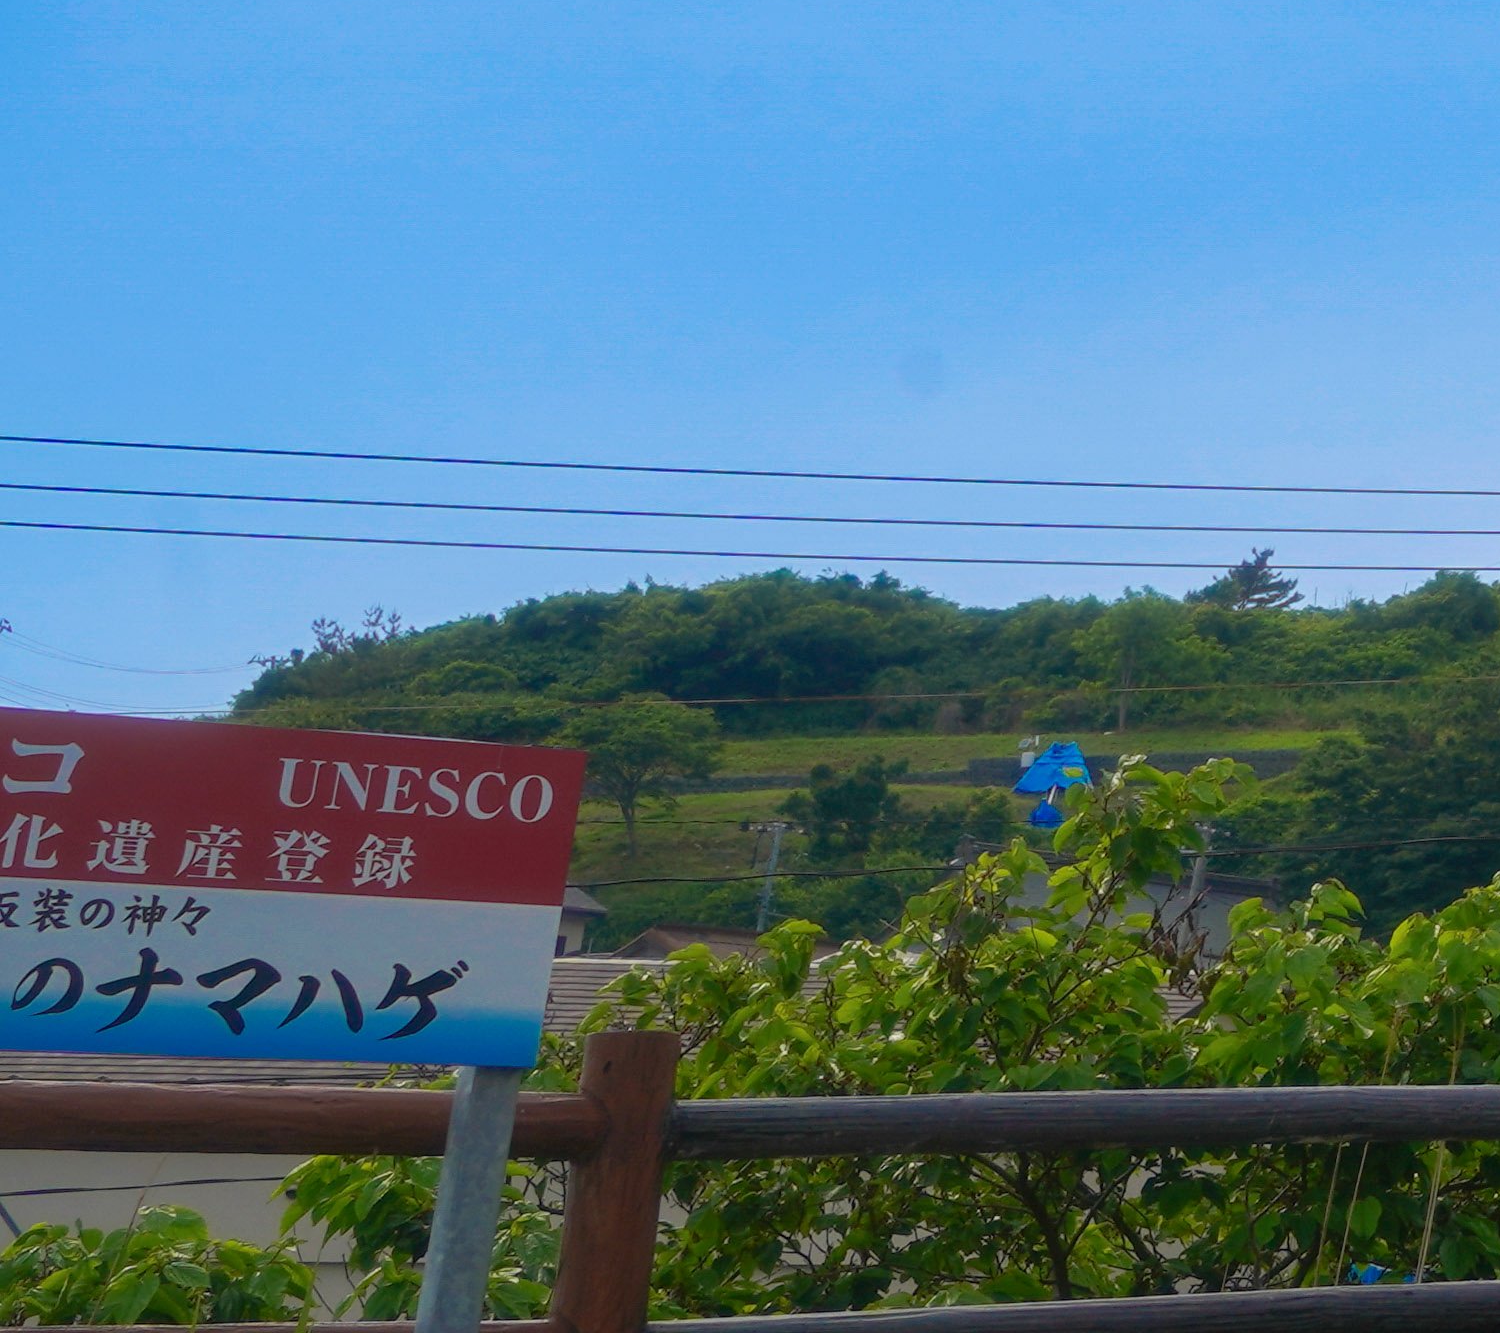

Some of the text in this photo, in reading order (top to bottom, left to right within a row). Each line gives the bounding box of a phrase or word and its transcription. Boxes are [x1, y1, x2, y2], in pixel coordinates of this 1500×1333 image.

[2, 737, 86, 795] コ
[278, 757, 555, 823] UNESCO
[0, 812, 417, 889] 化遺産登録
[10, 947, 470, 1042] のナマハゲ
